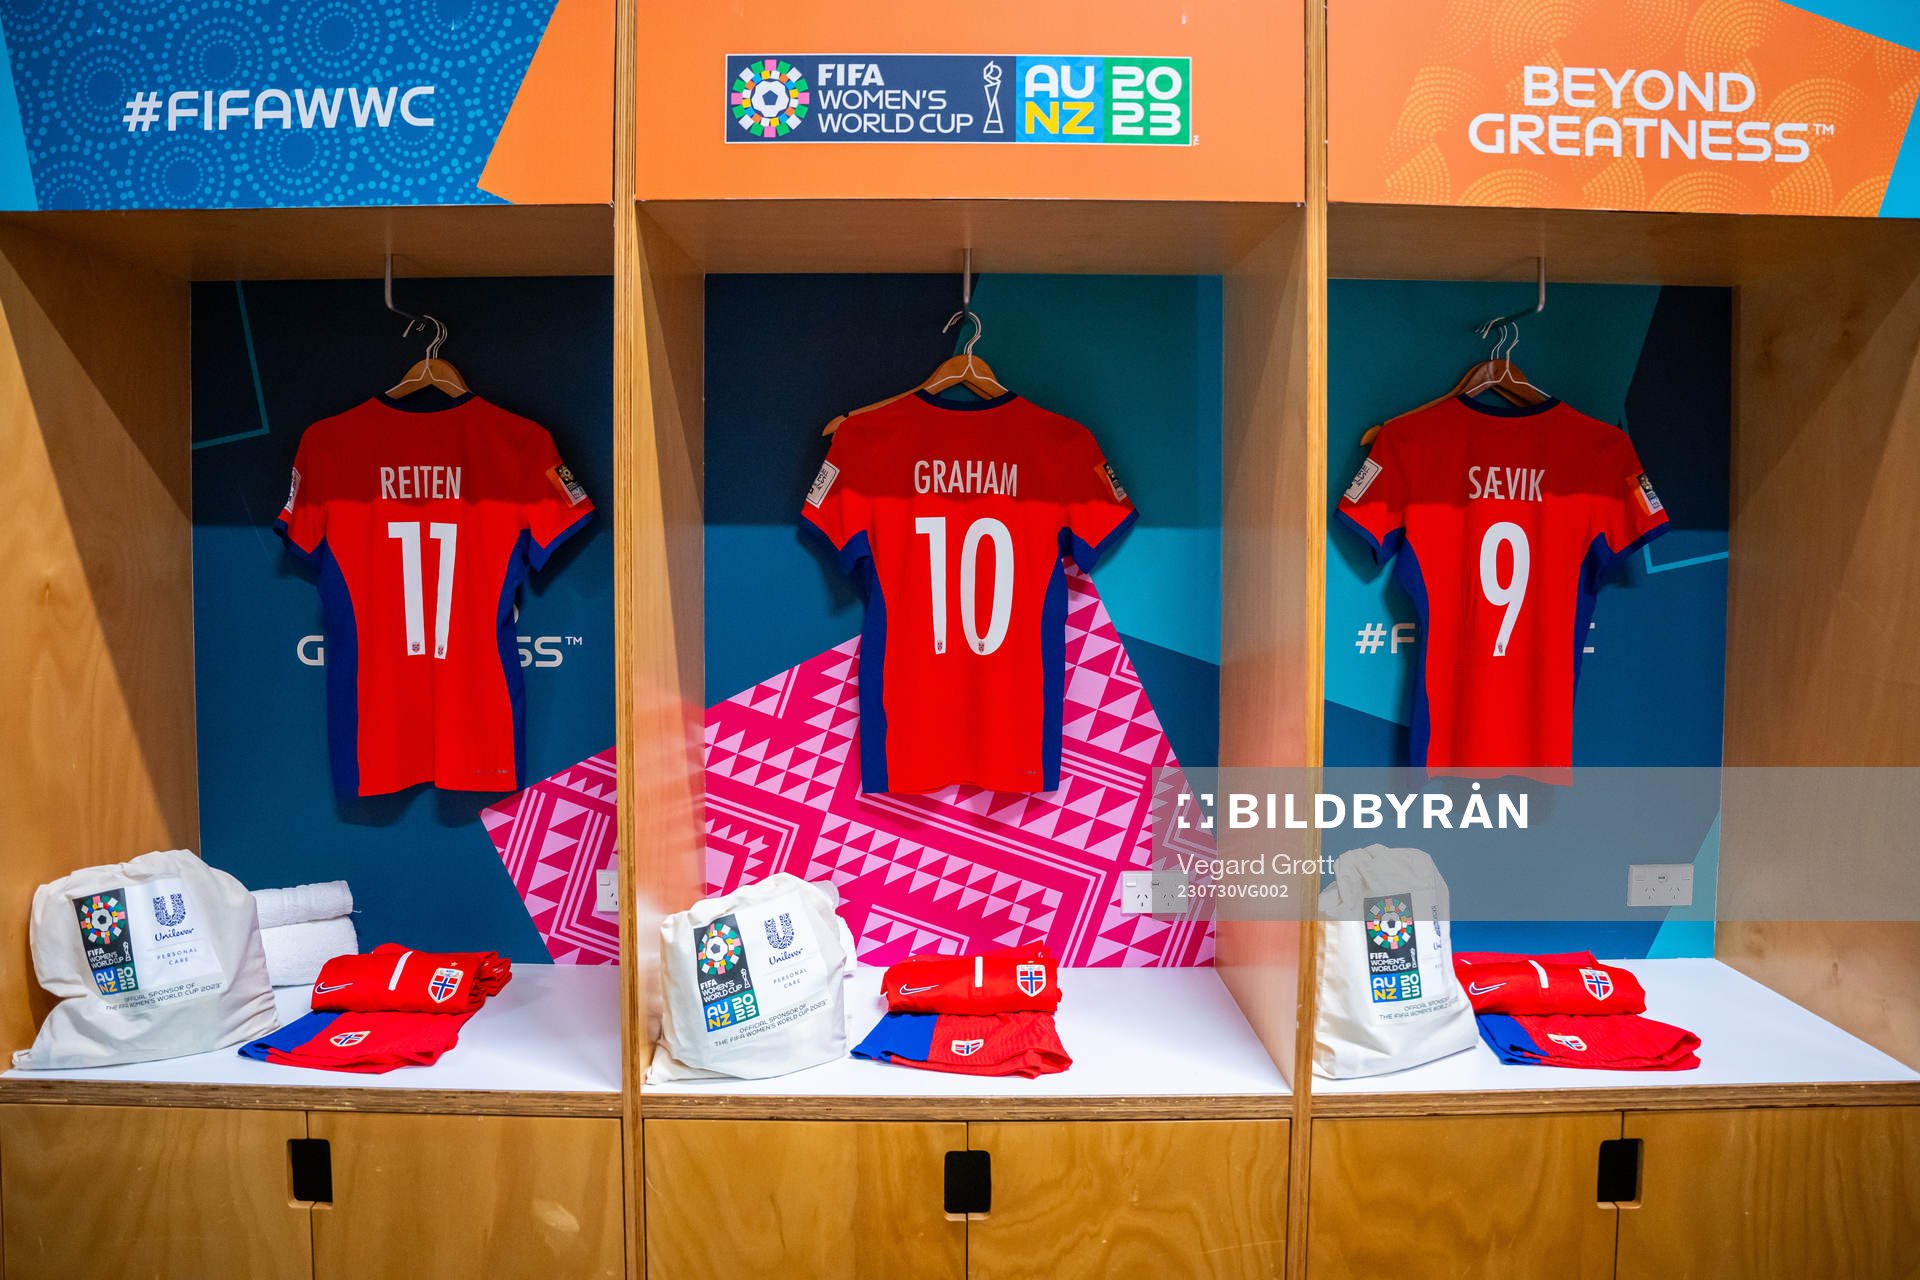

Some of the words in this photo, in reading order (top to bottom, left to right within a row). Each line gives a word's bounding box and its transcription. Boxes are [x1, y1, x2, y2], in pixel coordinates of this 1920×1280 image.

[818, 63, 885, 86] FIFA
[1025, 64, 1094, 97] AU
[1112, 66, 1183, 100] 20
[1523, 65, 1755, 113] BEYOND
[818, 89, 947, 110] WOMEN'S
[122, 86, 435, 132] #FIFAWWC
[818, 113, 915, 134] WORLD
[919, 114, 973, 134] CUP
[1025, 102, 1094, 134] NZ
[1112, 103, 1182, 136] 23
[380, 466, 462, 500] REITEN
[914, 460, 1018, 497] GRAHAM
[1468, 466, 1546, 502] SÆVIK
[388, 521, 457, 659] 11
[915, 516, 1015, 656] 10
[1480, 521, 1530, 657] 9
[155, 928, 194, 941] Unilever
[87, 948, 104, 957] FIFA
[90, 952, 118, 962] WOMEN'S
[157, 948, 197, 960] PERSONAL
[769, 948, 803, 965] Unilever
[91, 959, 113, 968] WORLD
[114, 956, 124, 964] CUP
[168, 958, 188, 966] CARE
[1370, 958, 1406, 966] WOMEN'S
[96, 970, 114, 983] AU
[116, 967, 134, 979] 20
[774, 968, 808, 984] PERSONAL
[1400, 974, 1419, 986] 20
[99, 981, 118, 993] NZ
[120, 978, 136, 990] 23
[700, 979, 718, 990] FIFA
[702, 980, 735, 996] WOMEN'S
[784, 979, 800, 988] CARE
[1373, 976, 1396, 988] AU
[148, 984, 184, 998] SPONSOR
[158, 992, 182, 1002] WORLD
[704, 990, 728, 1002] WORLD
[728, 984, 742, 994] CUP
[1374, 988, 1397, 1000] NZ
[1402, 986, 1420, 998] 23
[707, 1001, 728, 1018] AU
[732, 994, 754, 1010] 20
[708, 1013, 732, 1030] NZ
[734, 1005, 756, 1022] 23
[740, 1020, 768, 1033] OFFICIAL
[769, 1008, 798, 1022] SPONSOR
[799, 1003, 807, 1011] OF
[714, 1038, 728, 1046] THE
[730, 1034, 746, 1043] FIFA
[746, 1024, 776, 1038] WOMEN'S
[777, 1014, 798, 1026] WORLD
[798, 1009, 810, 1017] CUP
